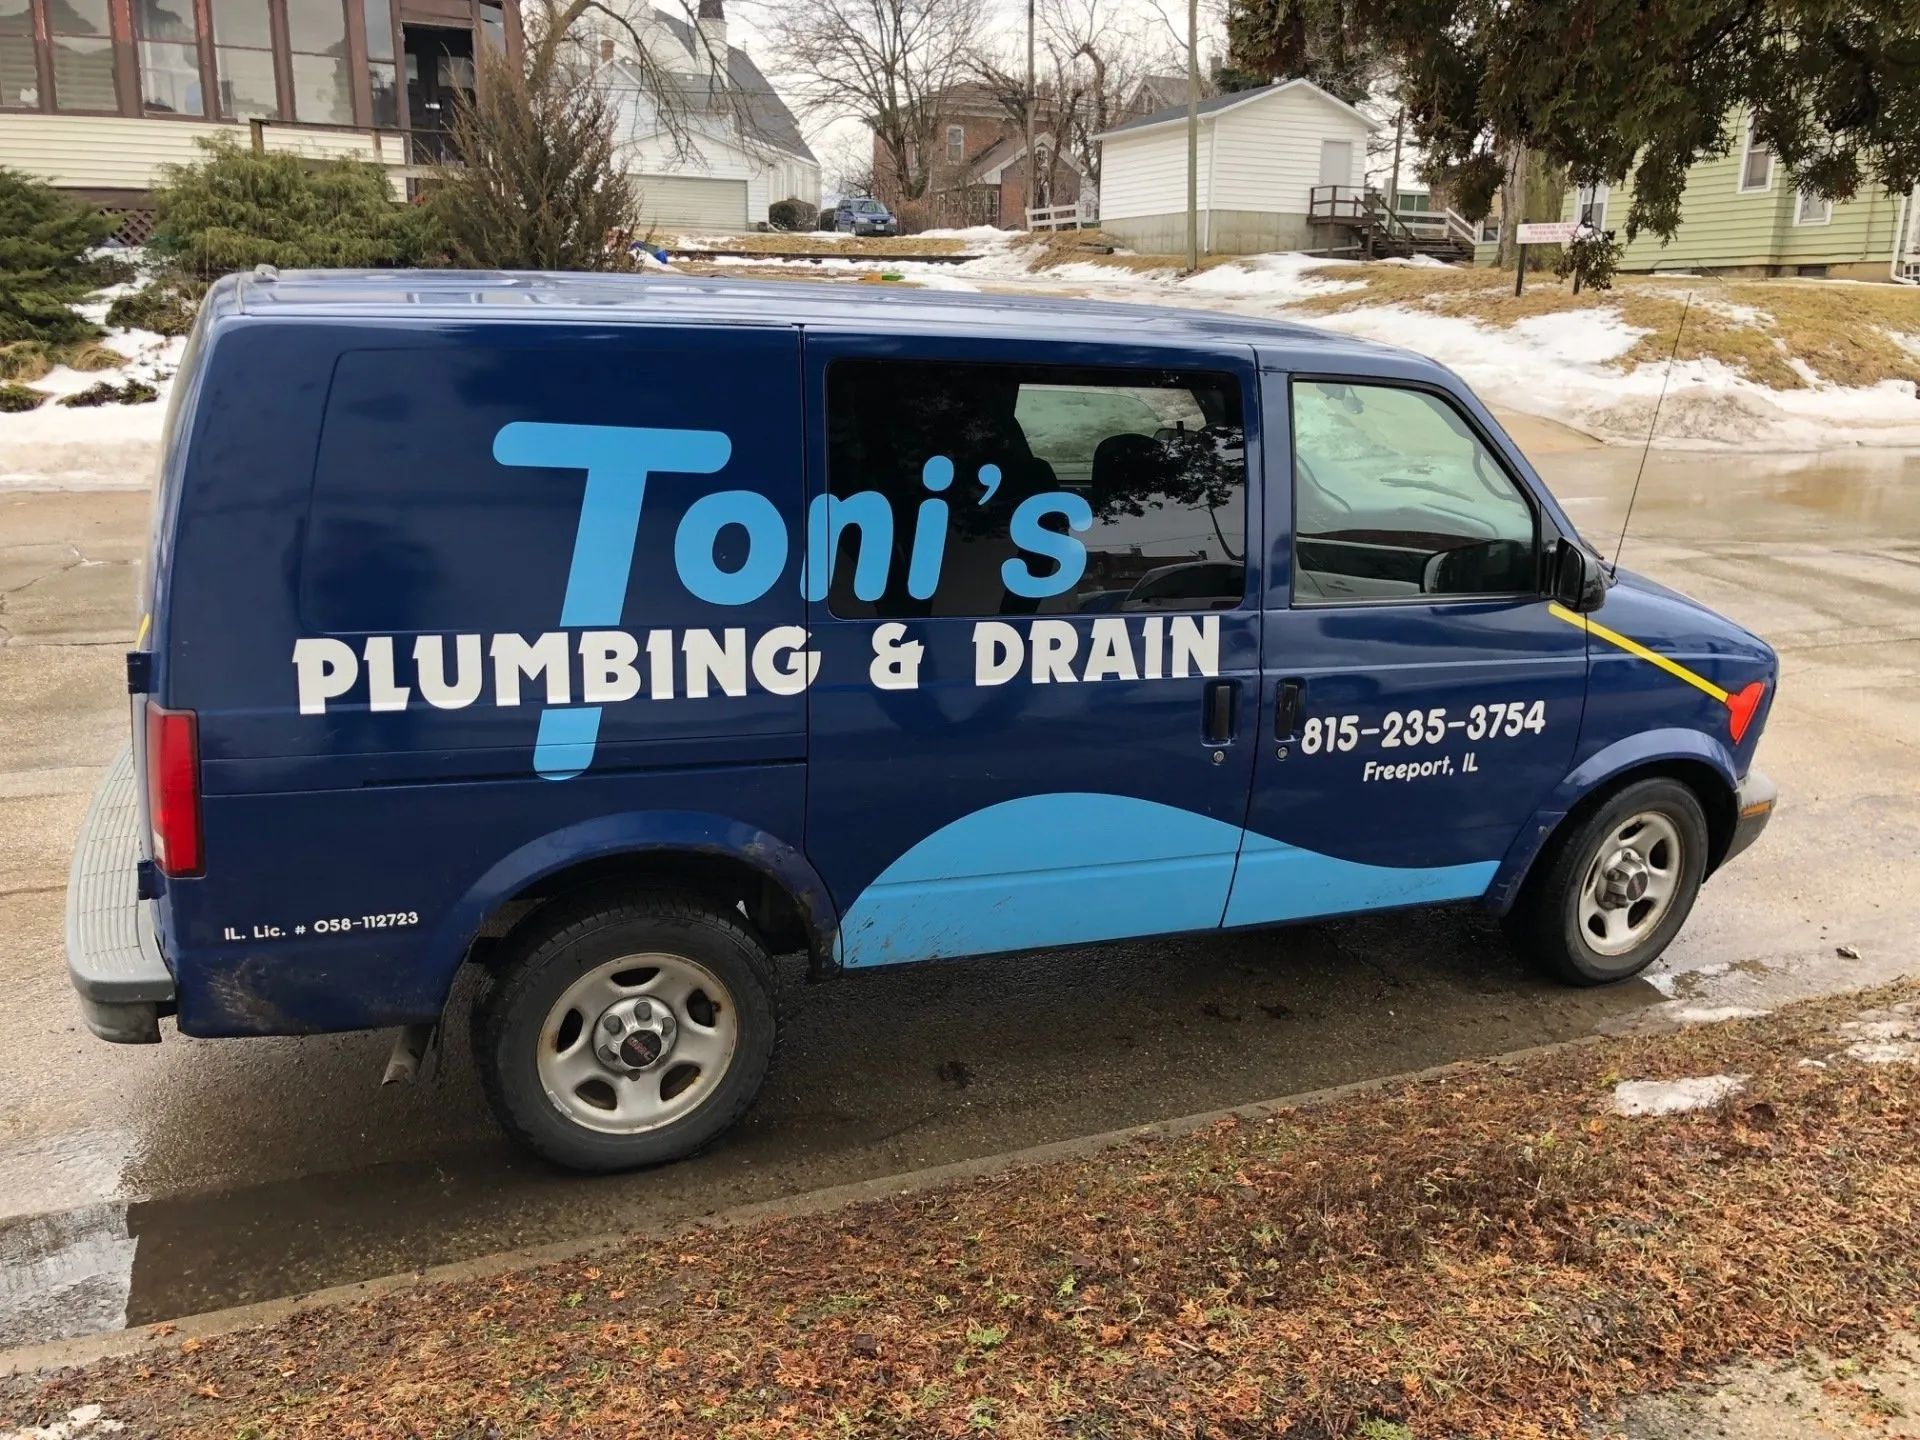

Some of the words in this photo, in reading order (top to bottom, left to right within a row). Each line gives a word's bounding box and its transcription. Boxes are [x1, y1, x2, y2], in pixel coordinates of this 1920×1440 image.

[493, 422, 1093, 780] Toni's
[291, 625, 821, 715] PLUMBING
[869, 622, 924, 690] &
[972, 615, 1220, 687] DRAIN
[1301, 700, 1546, 755] 815-235-3754
[1363, 755, 1454, 782] Freeport,
[1462, 752, 1479, 772] IL
[224, 927, 246, 940] IL.
[253, 924, 287, 939] Lic.
[294, 924, 306, 935] #
